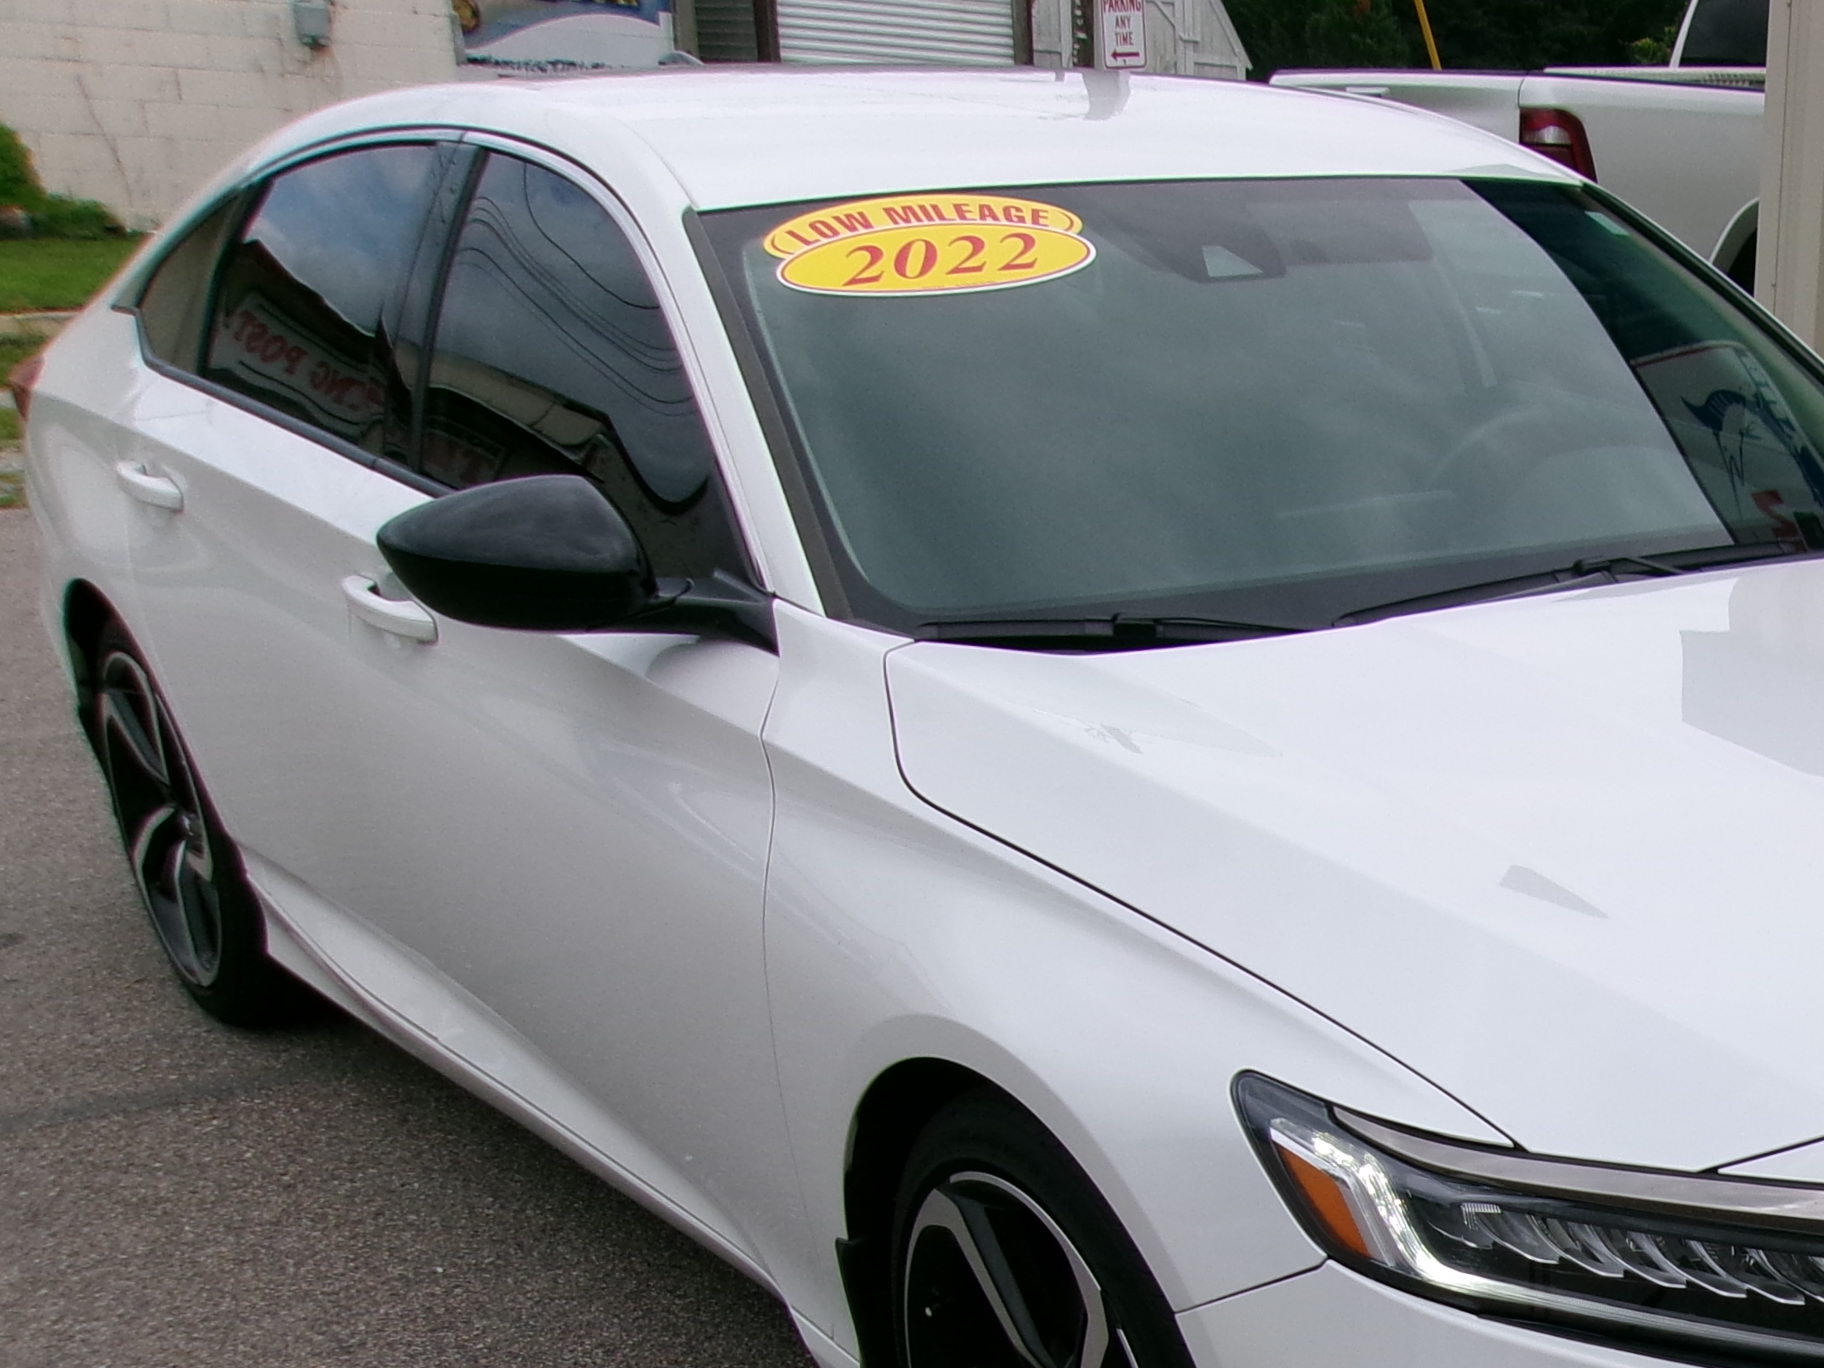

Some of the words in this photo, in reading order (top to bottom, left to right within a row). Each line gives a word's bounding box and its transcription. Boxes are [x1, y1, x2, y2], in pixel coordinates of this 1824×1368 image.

[1103, 0, 1141, 13] PARKING
[1115, 15, 1131, 29] ANY
[1115, 32, 1134, 47] TIME
[786, 210, 875, 247] LOW
[882, 203, 1050, 227] MILEAGE
[842, 232, 1039, 287] 2022
